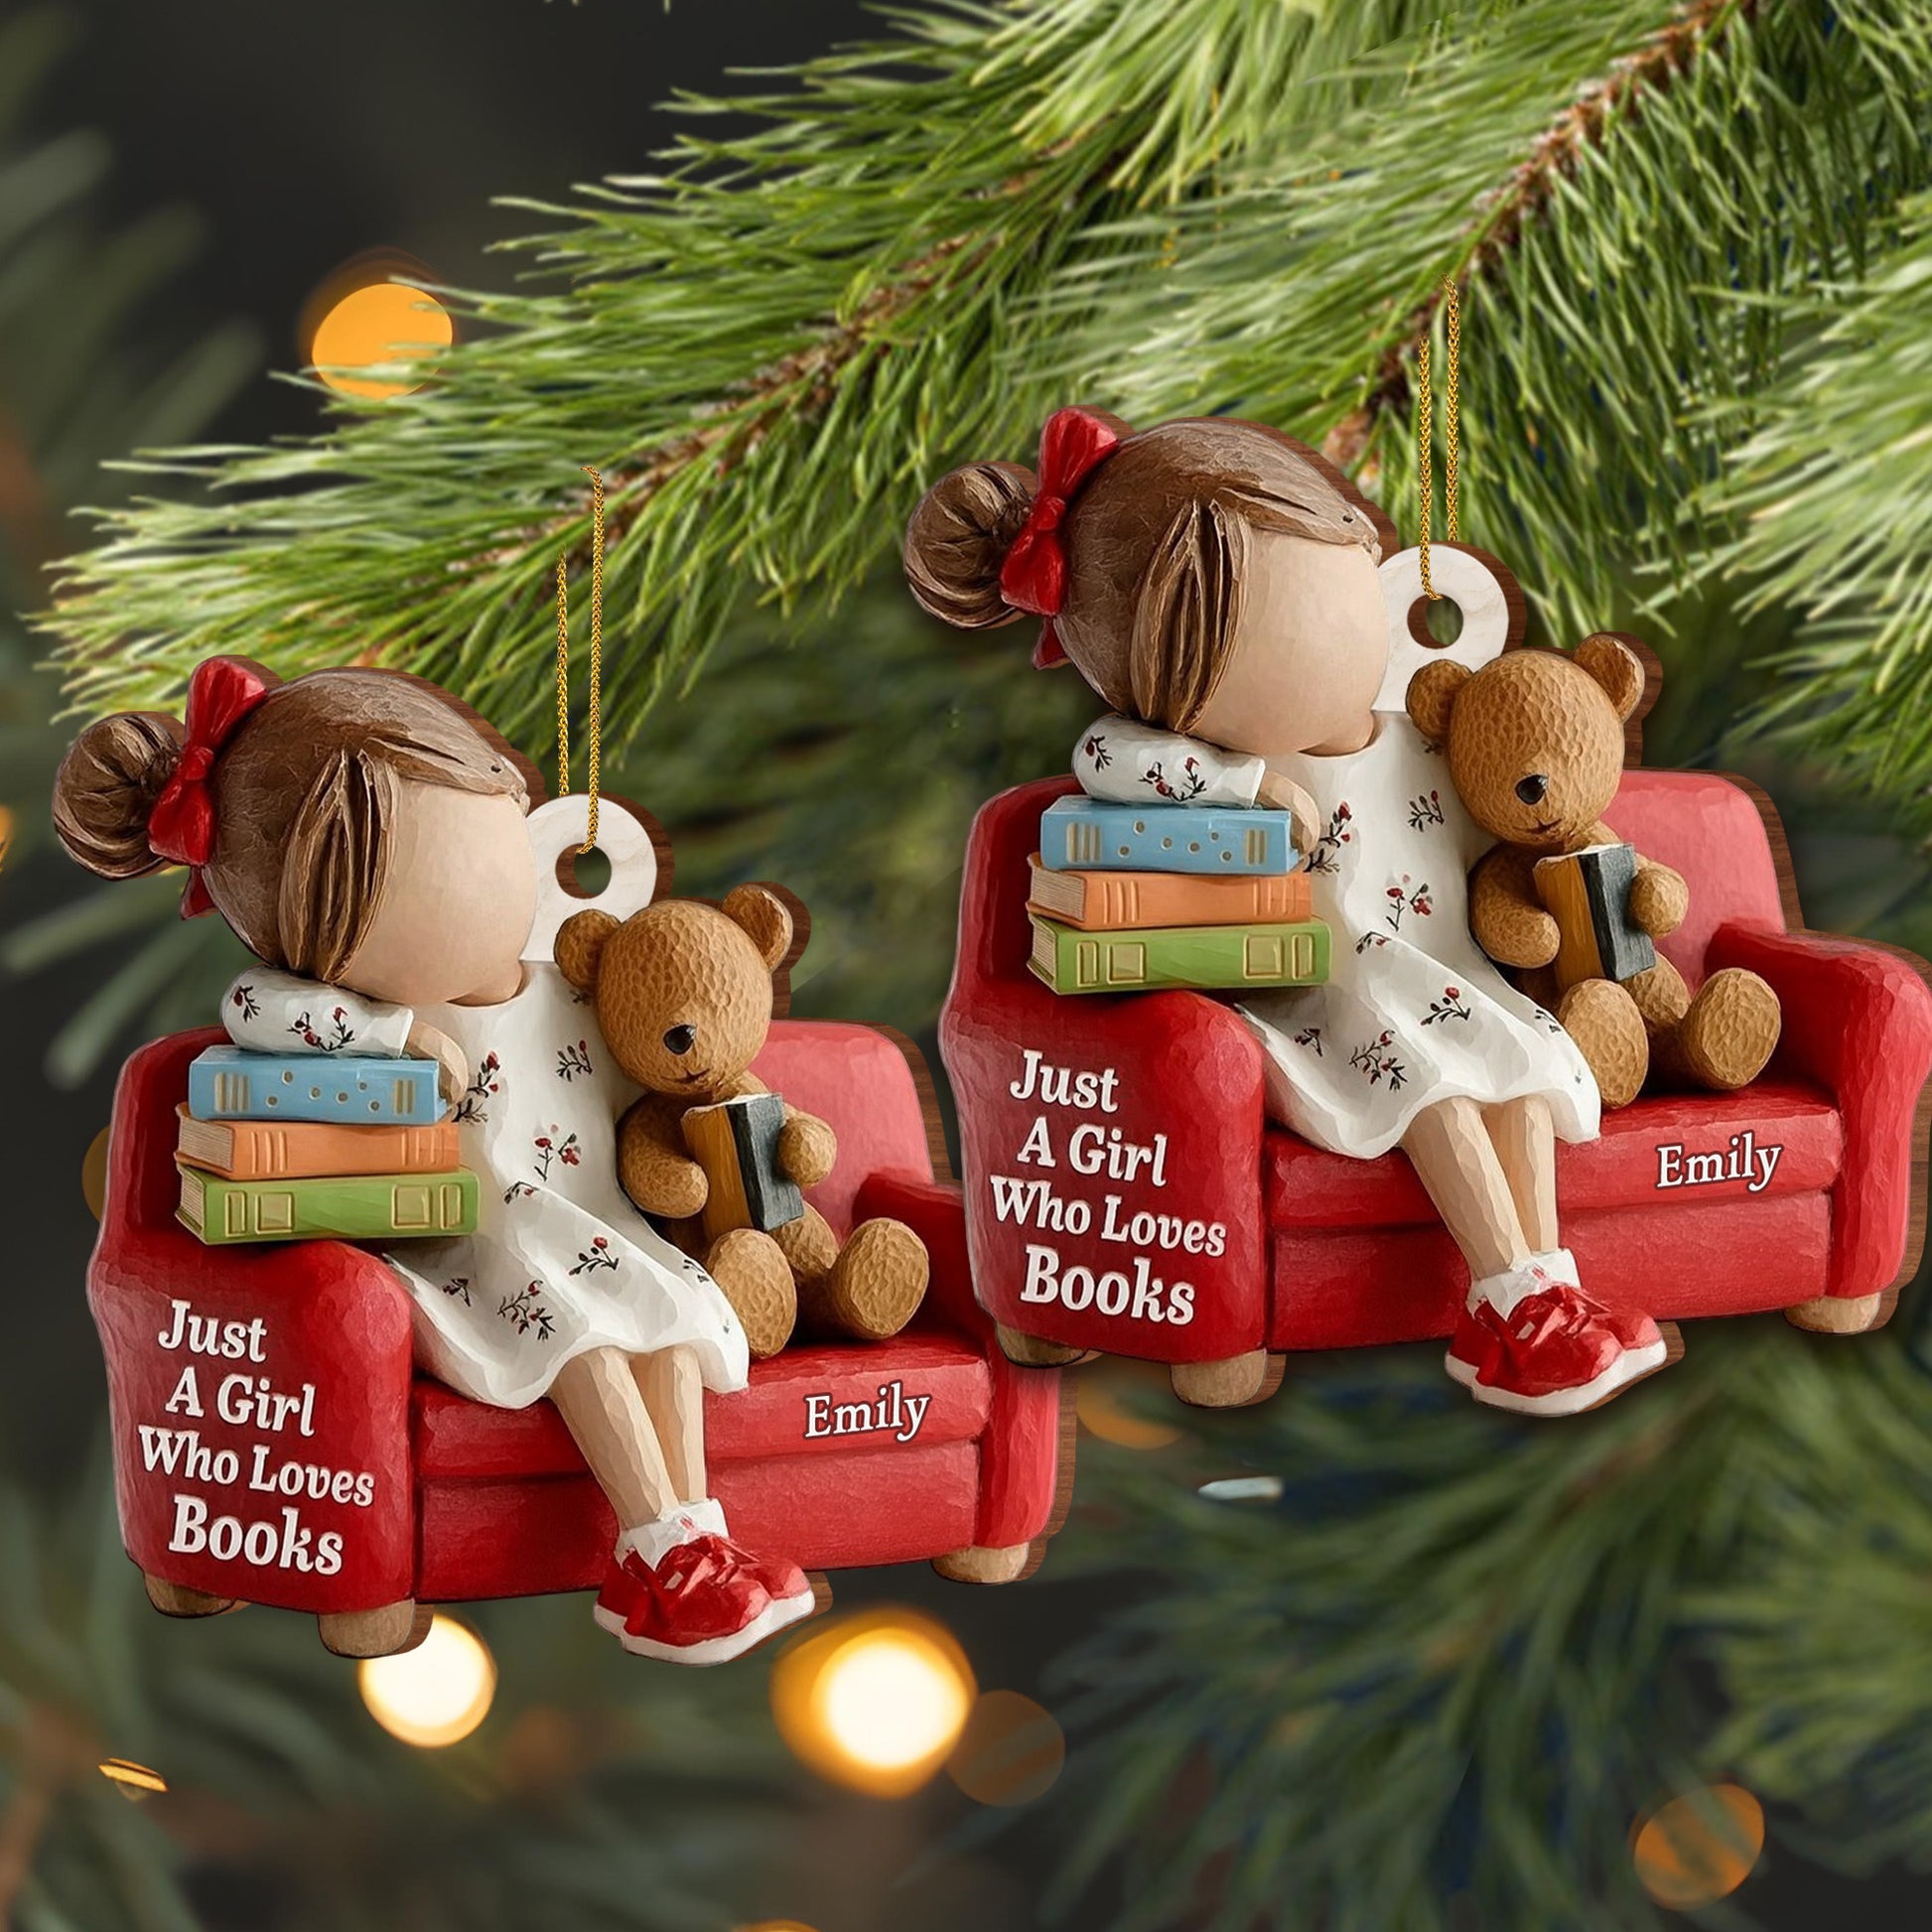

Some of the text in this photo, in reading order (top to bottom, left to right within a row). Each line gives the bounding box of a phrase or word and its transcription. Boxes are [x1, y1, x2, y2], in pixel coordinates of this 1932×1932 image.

[1010, 1049, 1119, 1112] Just
[1017, 1115, 1168, 1186] A Girl
[1657, 1132, 1782, 1192] Emily
[989, 1174, 1226, 1257] Who Loves
[1020, 1243, 1195, 1325] Books
[158, 1299, 268, 1363] Just
[165, 1365, 316, 1437] A Girl
[805, 1382, 930, 1442] Emily
[137, 1424, 374, 1507] Who Loves
[168, 1493, 344, 1576] Books
